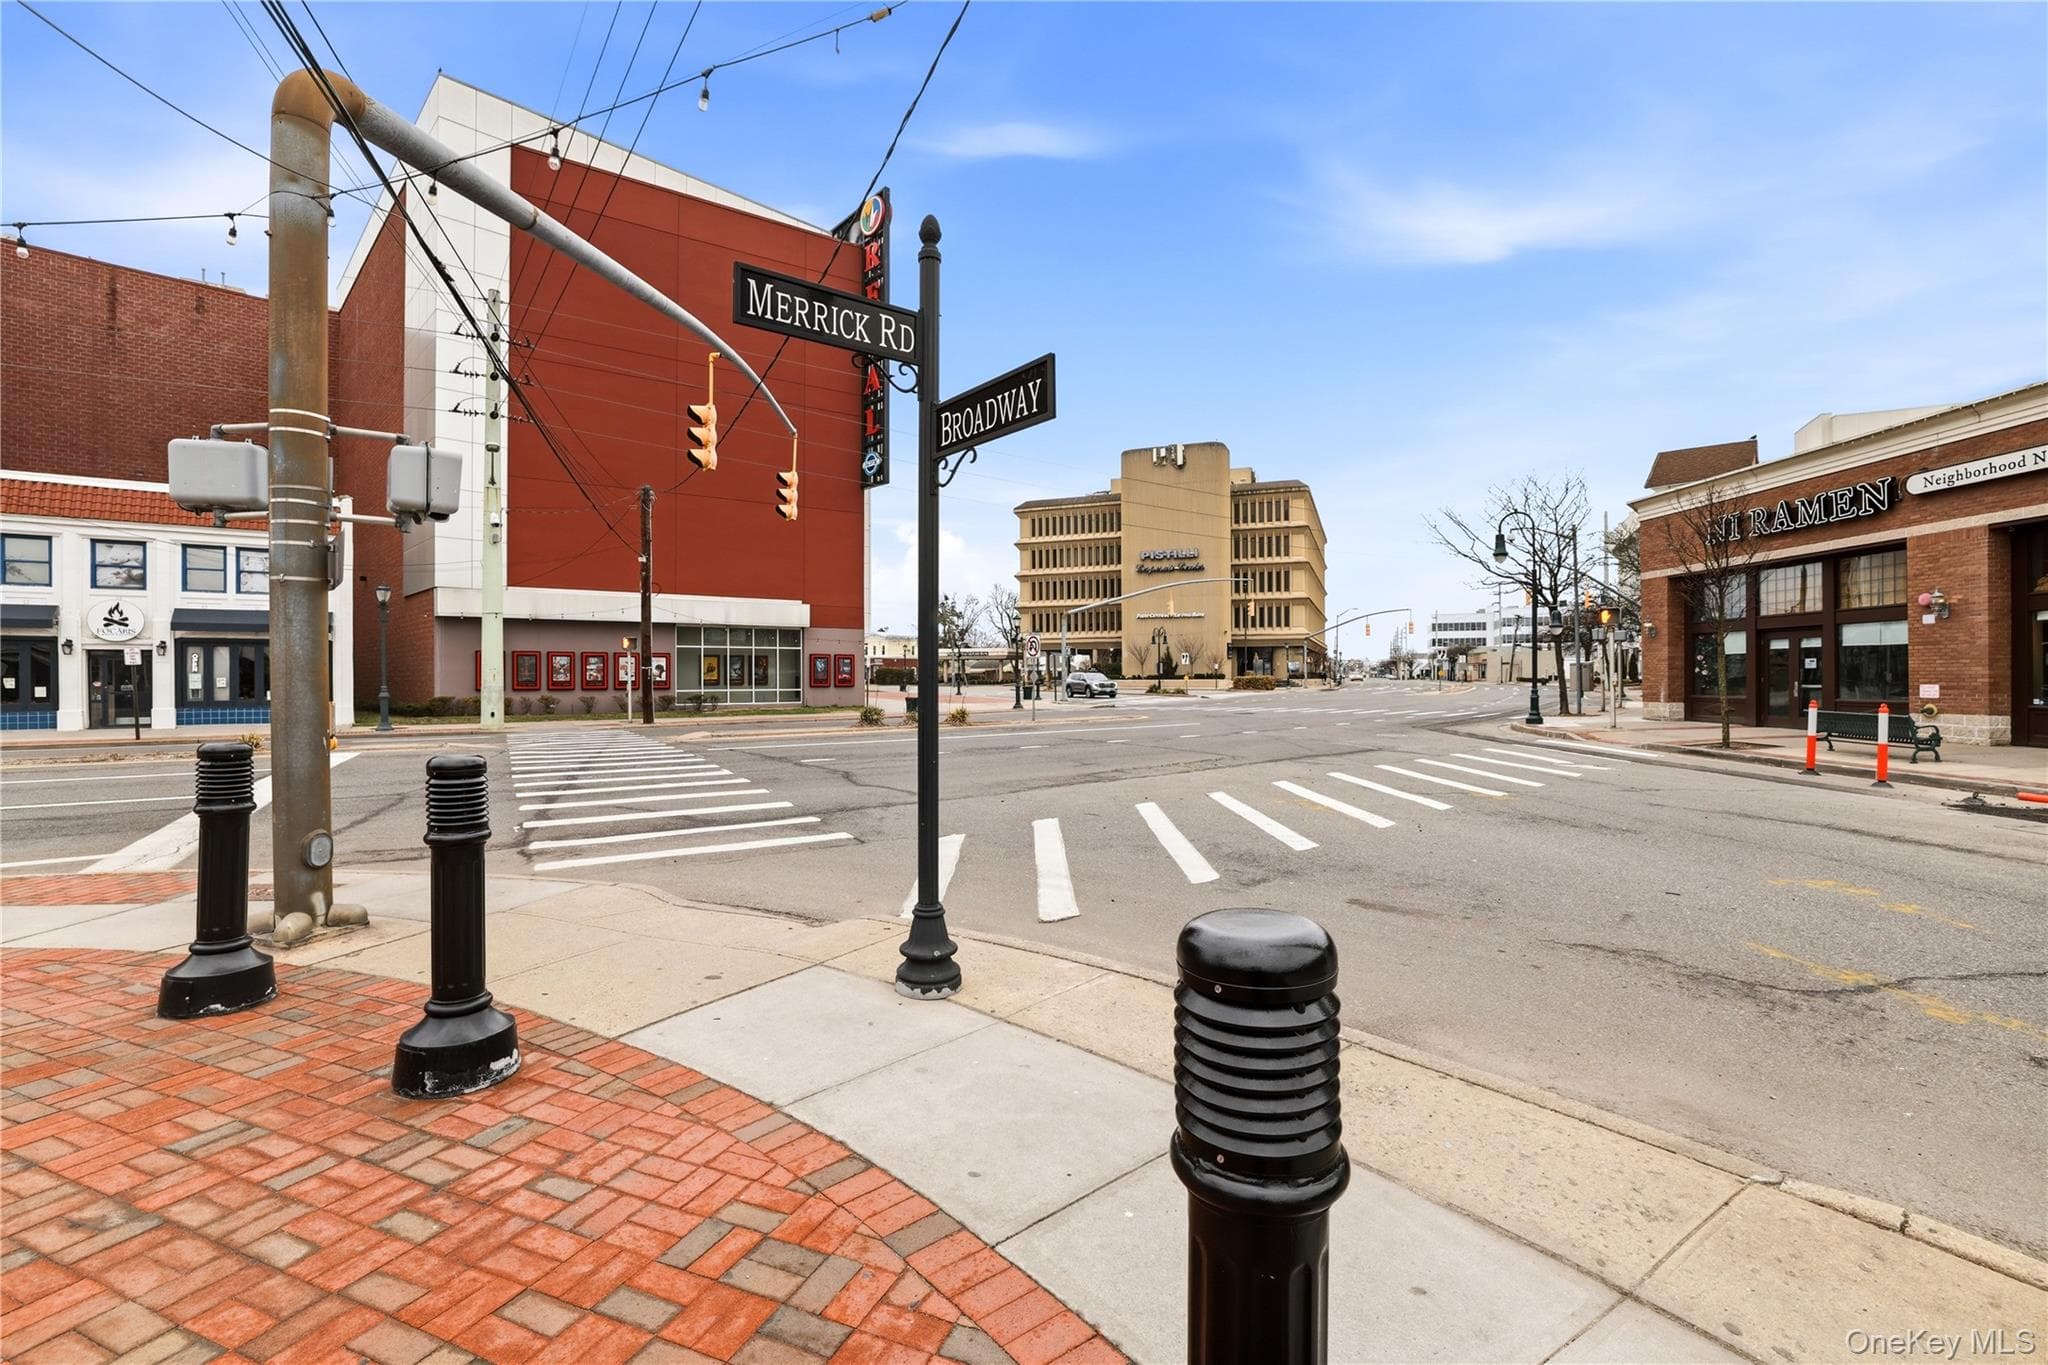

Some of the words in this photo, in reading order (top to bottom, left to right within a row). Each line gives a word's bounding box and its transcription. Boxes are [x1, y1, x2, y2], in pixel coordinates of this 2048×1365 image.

[746, 277, 872, 344] MERRICK
[879, 312, 916, 354] RD
[863, 241, 881, 437] REAL
[940, 378, 1043, 448] BROADWAY
[1923, 454, 2027, 488] Neighborhood
[1749, 476, 1892, 537] RAMEN
